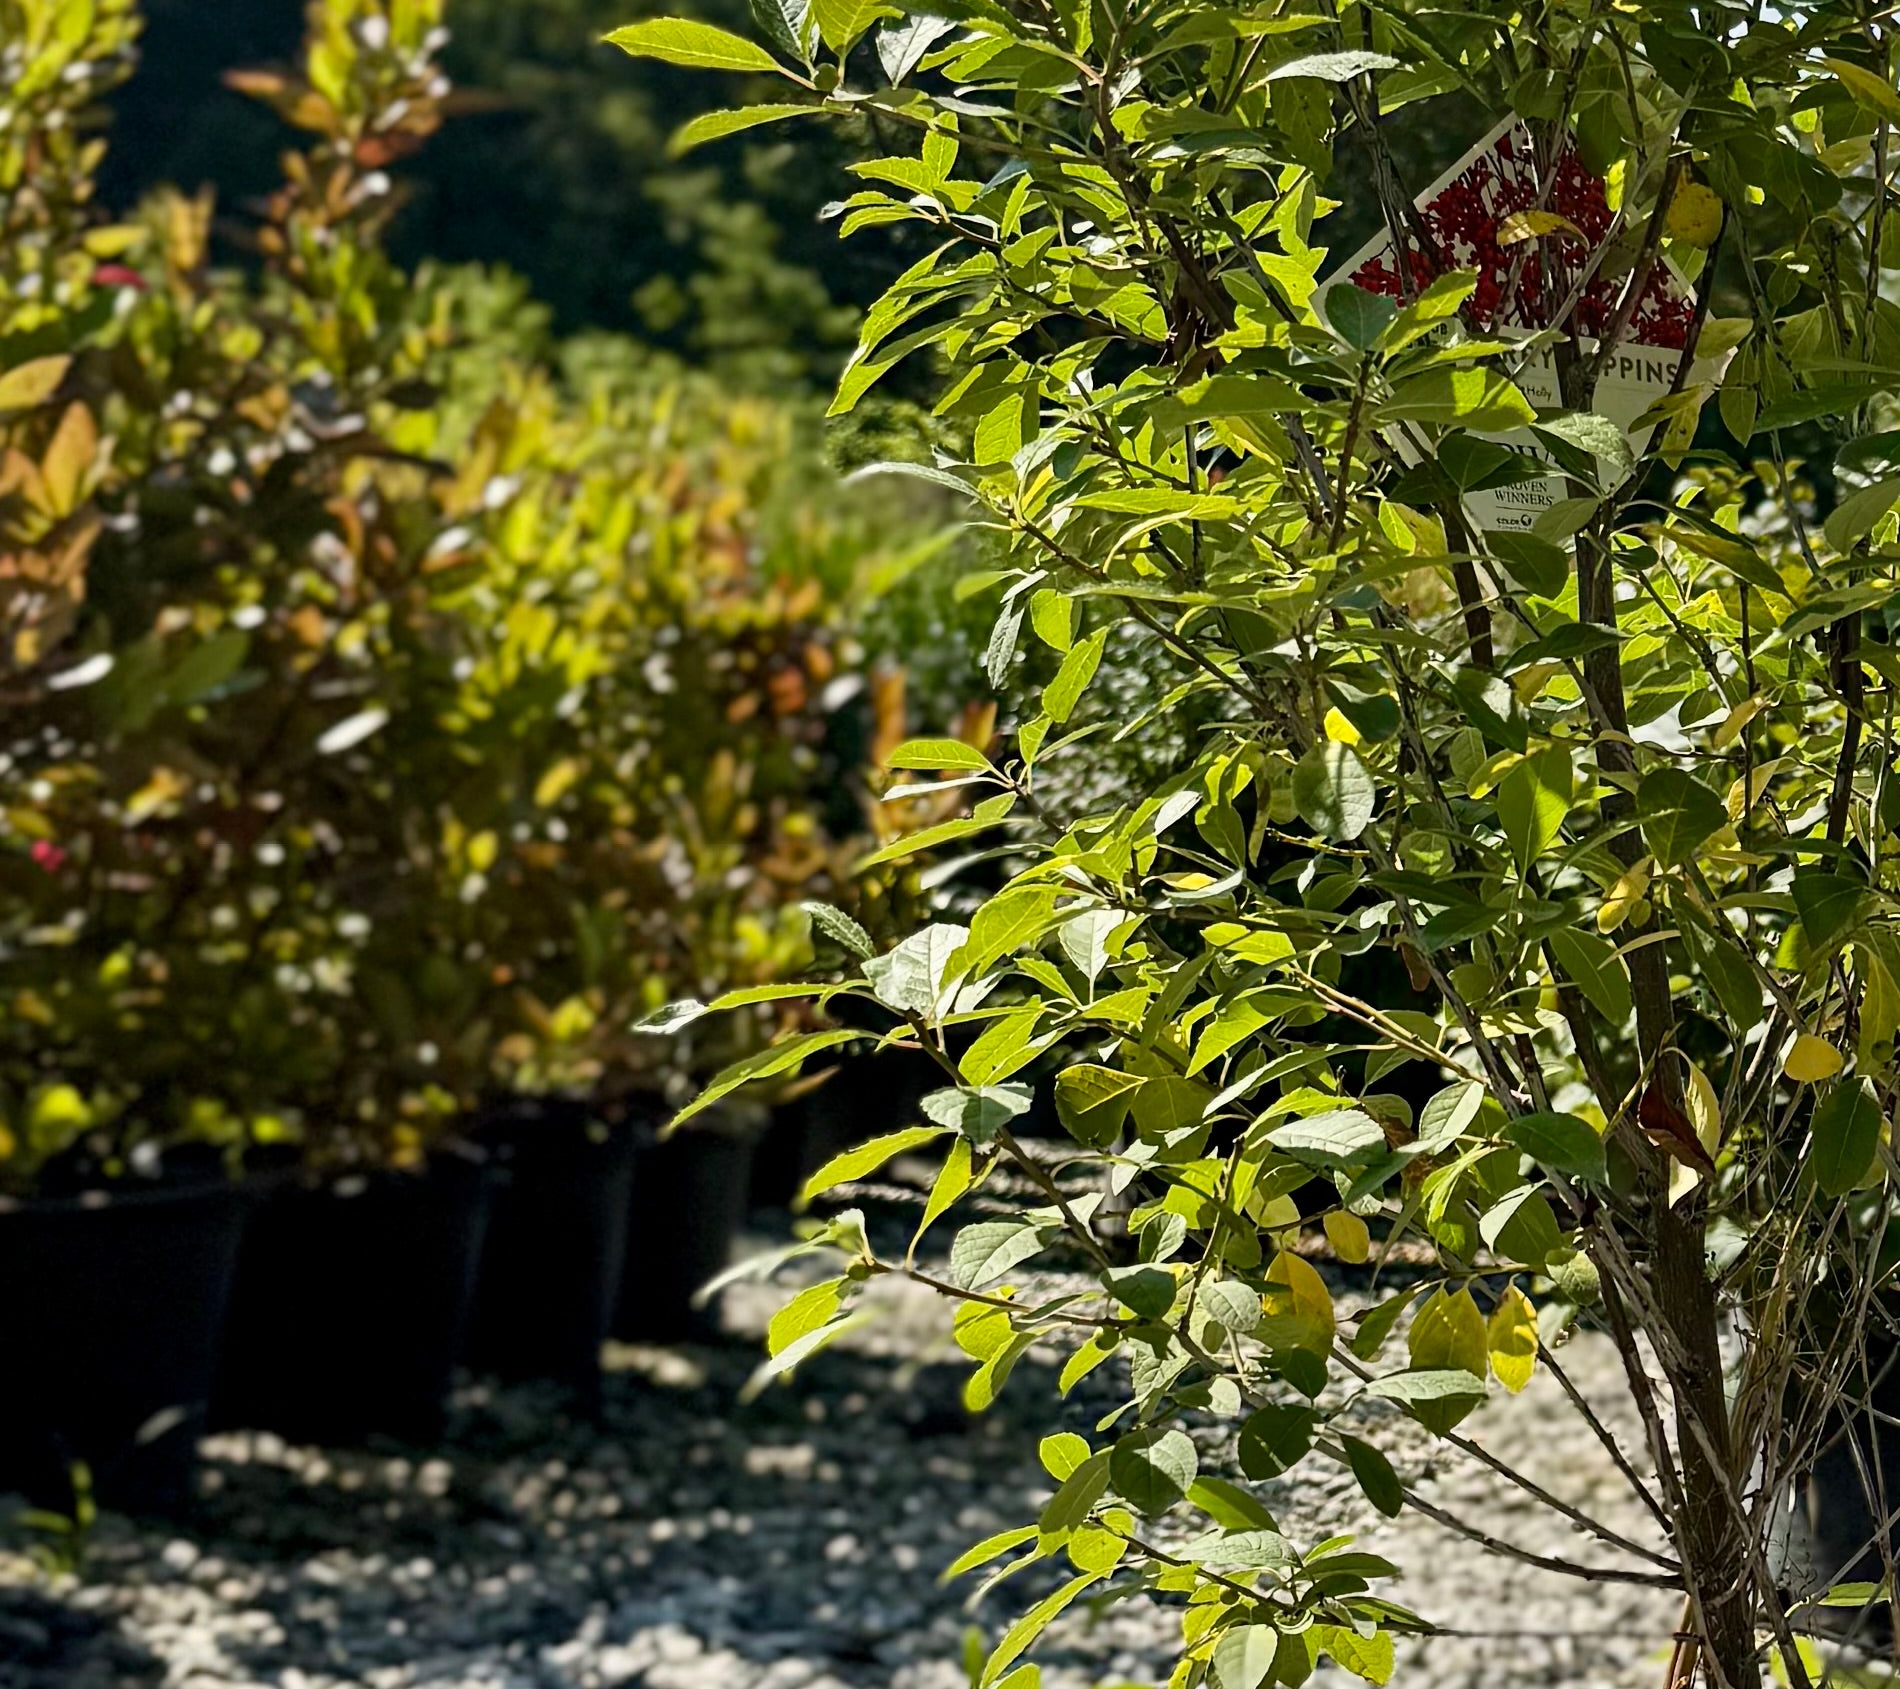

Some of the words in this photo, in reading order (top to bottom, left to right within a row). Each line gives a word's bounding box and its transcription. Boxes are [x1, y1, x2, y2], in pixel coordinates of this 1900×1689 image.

[1502, 344, 1553, 369] RRY
[1604, 355, 1678, 385] PPINS
[1508, 480, 1547, 493] OVEN
